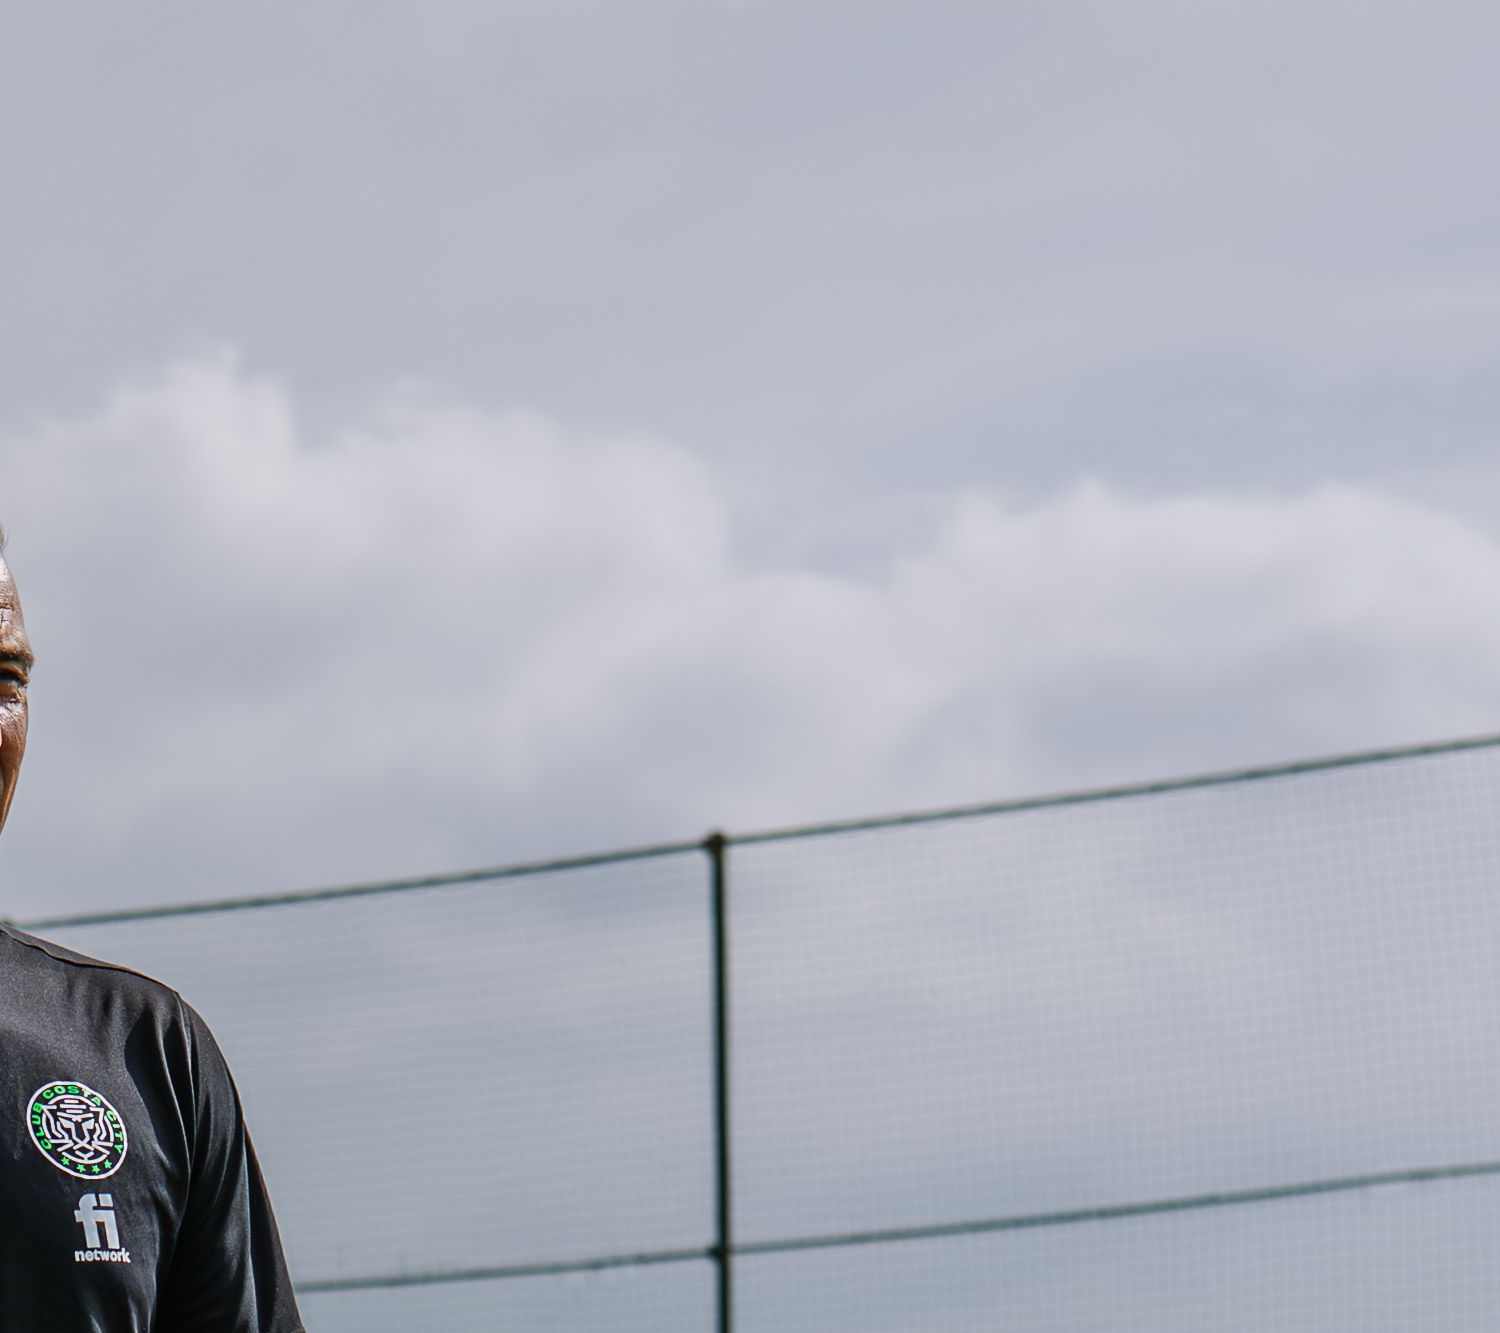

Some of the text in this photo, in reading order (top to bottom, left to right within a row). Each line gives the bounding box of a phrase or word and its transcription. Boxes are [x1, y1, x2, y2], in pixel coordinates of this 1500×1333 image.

[31, 1085, 125, 1154] CLUB COSTA CITY
[74, 1247, 132, 1264] network
